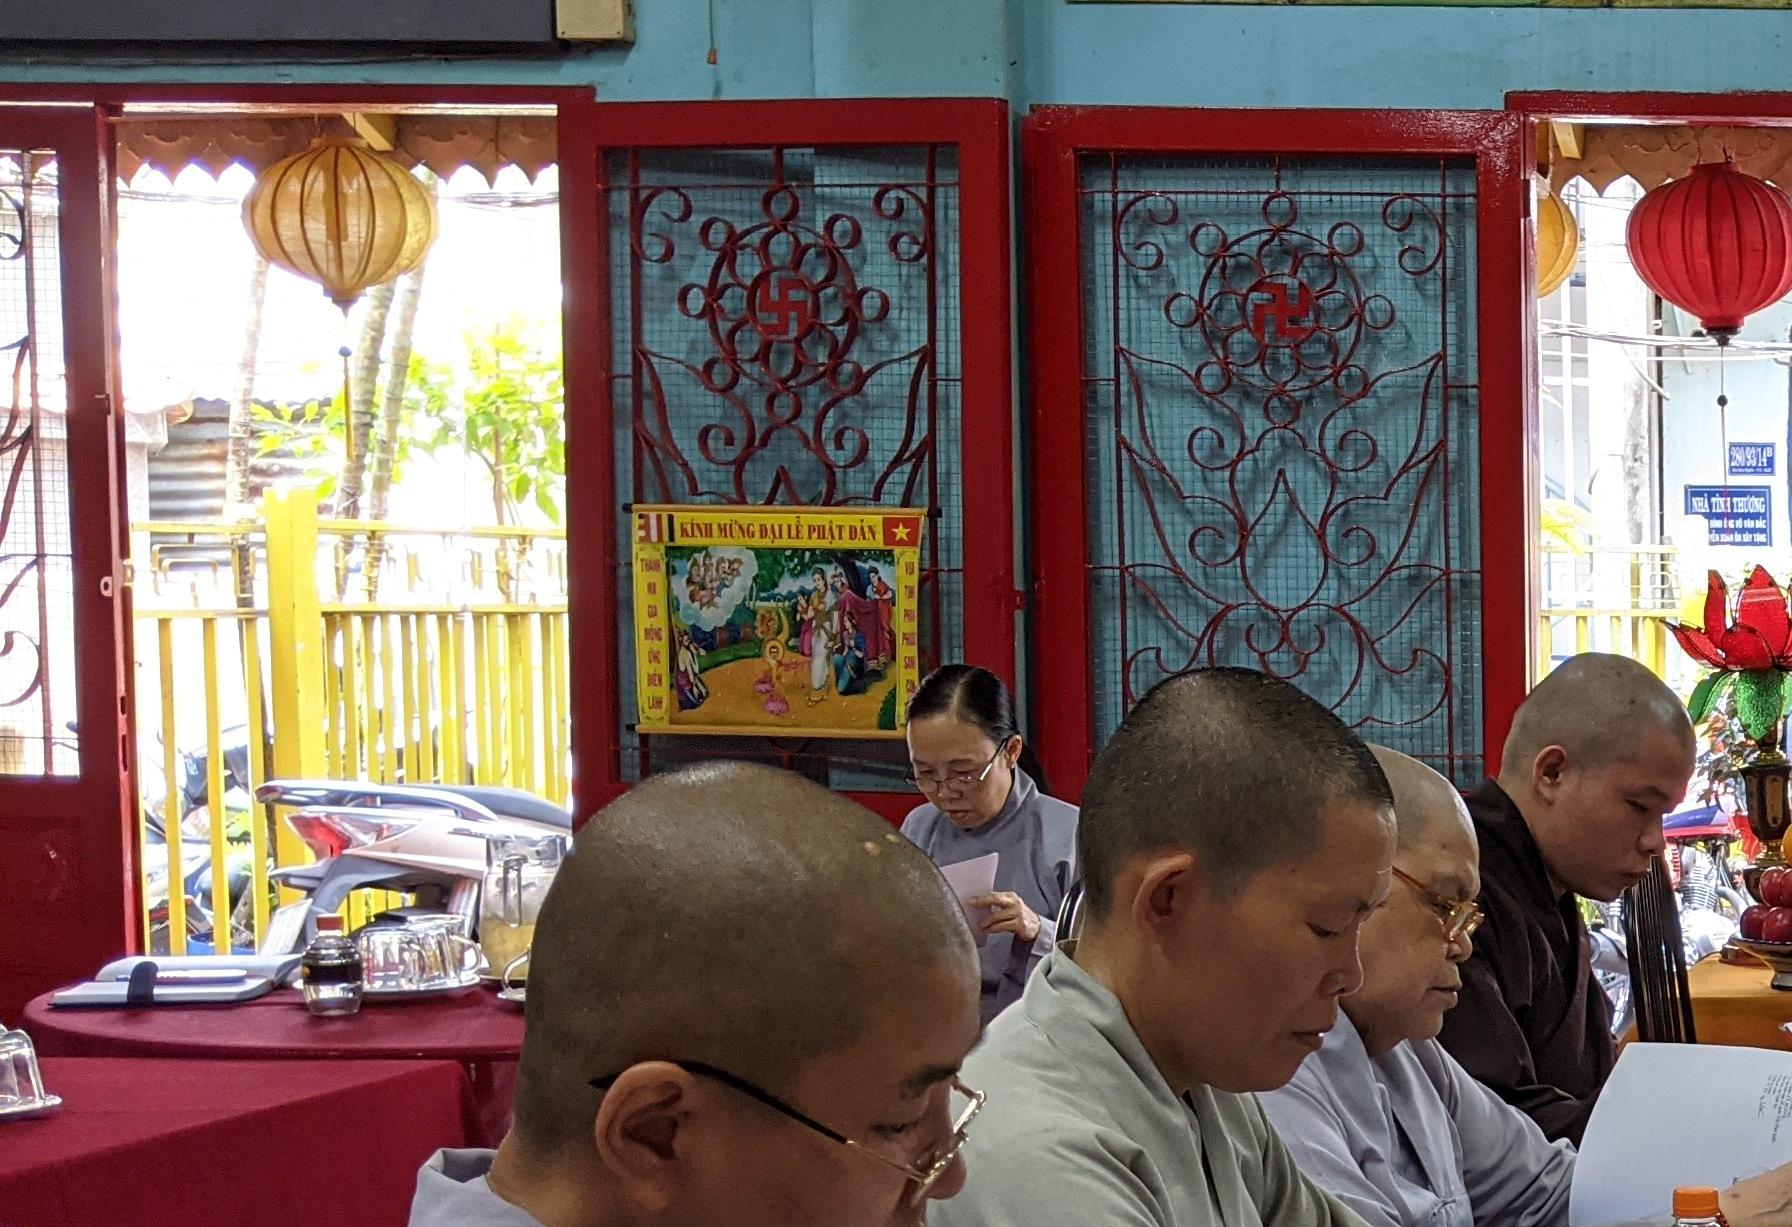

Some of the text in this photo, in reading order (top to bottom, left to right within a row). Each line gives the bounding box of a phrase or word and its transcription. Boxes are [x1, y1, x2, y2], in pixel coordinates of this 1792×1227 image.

[1692, 493, 1766, 512] NHÀ TÌNH THƯƠNG
[680, 515, 876, 545] KÍNH MỪNG ĐẠI LỄ PHẬT ĐẢN
